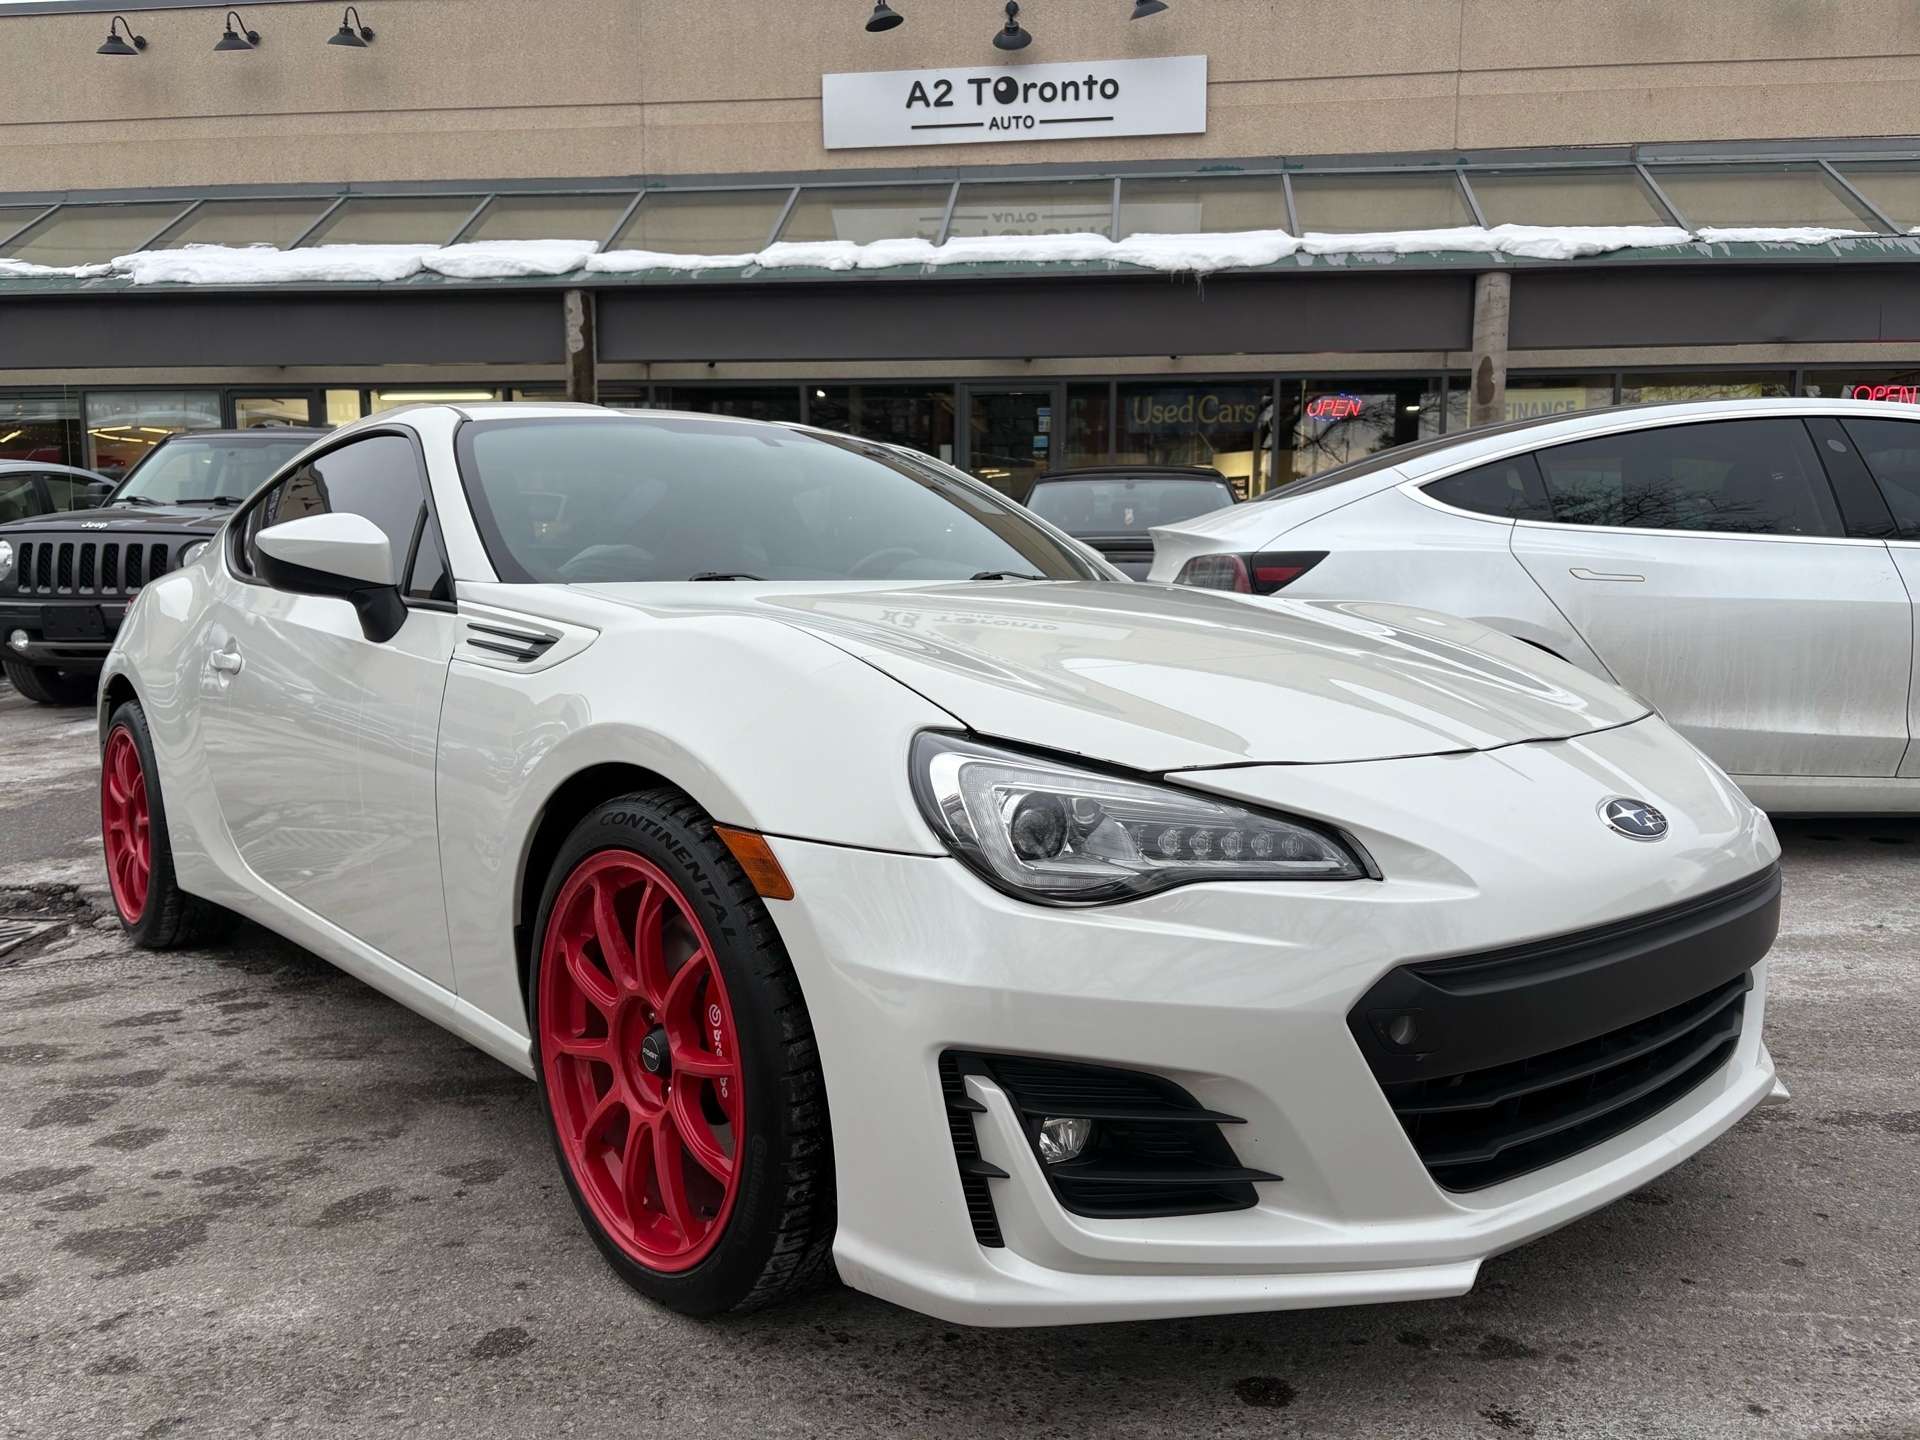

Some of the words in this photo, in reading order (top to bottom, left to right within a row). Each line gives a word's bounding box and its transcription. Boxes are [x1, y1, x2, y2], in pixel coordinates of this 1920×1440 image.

[906, 80, 954, 108] A2
[989, 115, 1035, 130] AUTO
[1853, 385, 1917, 404] OPEN
[1135, 395, 1194, 425] Used
[1198, 395, 1256, 424] Cars
[1306, 398, 1362, 417] OPEN
[81, 521, 108, 529] Jeep
[600, 811, 737, 945] CONTINENTAL
[713, 1029, 728, 1098] brebo
